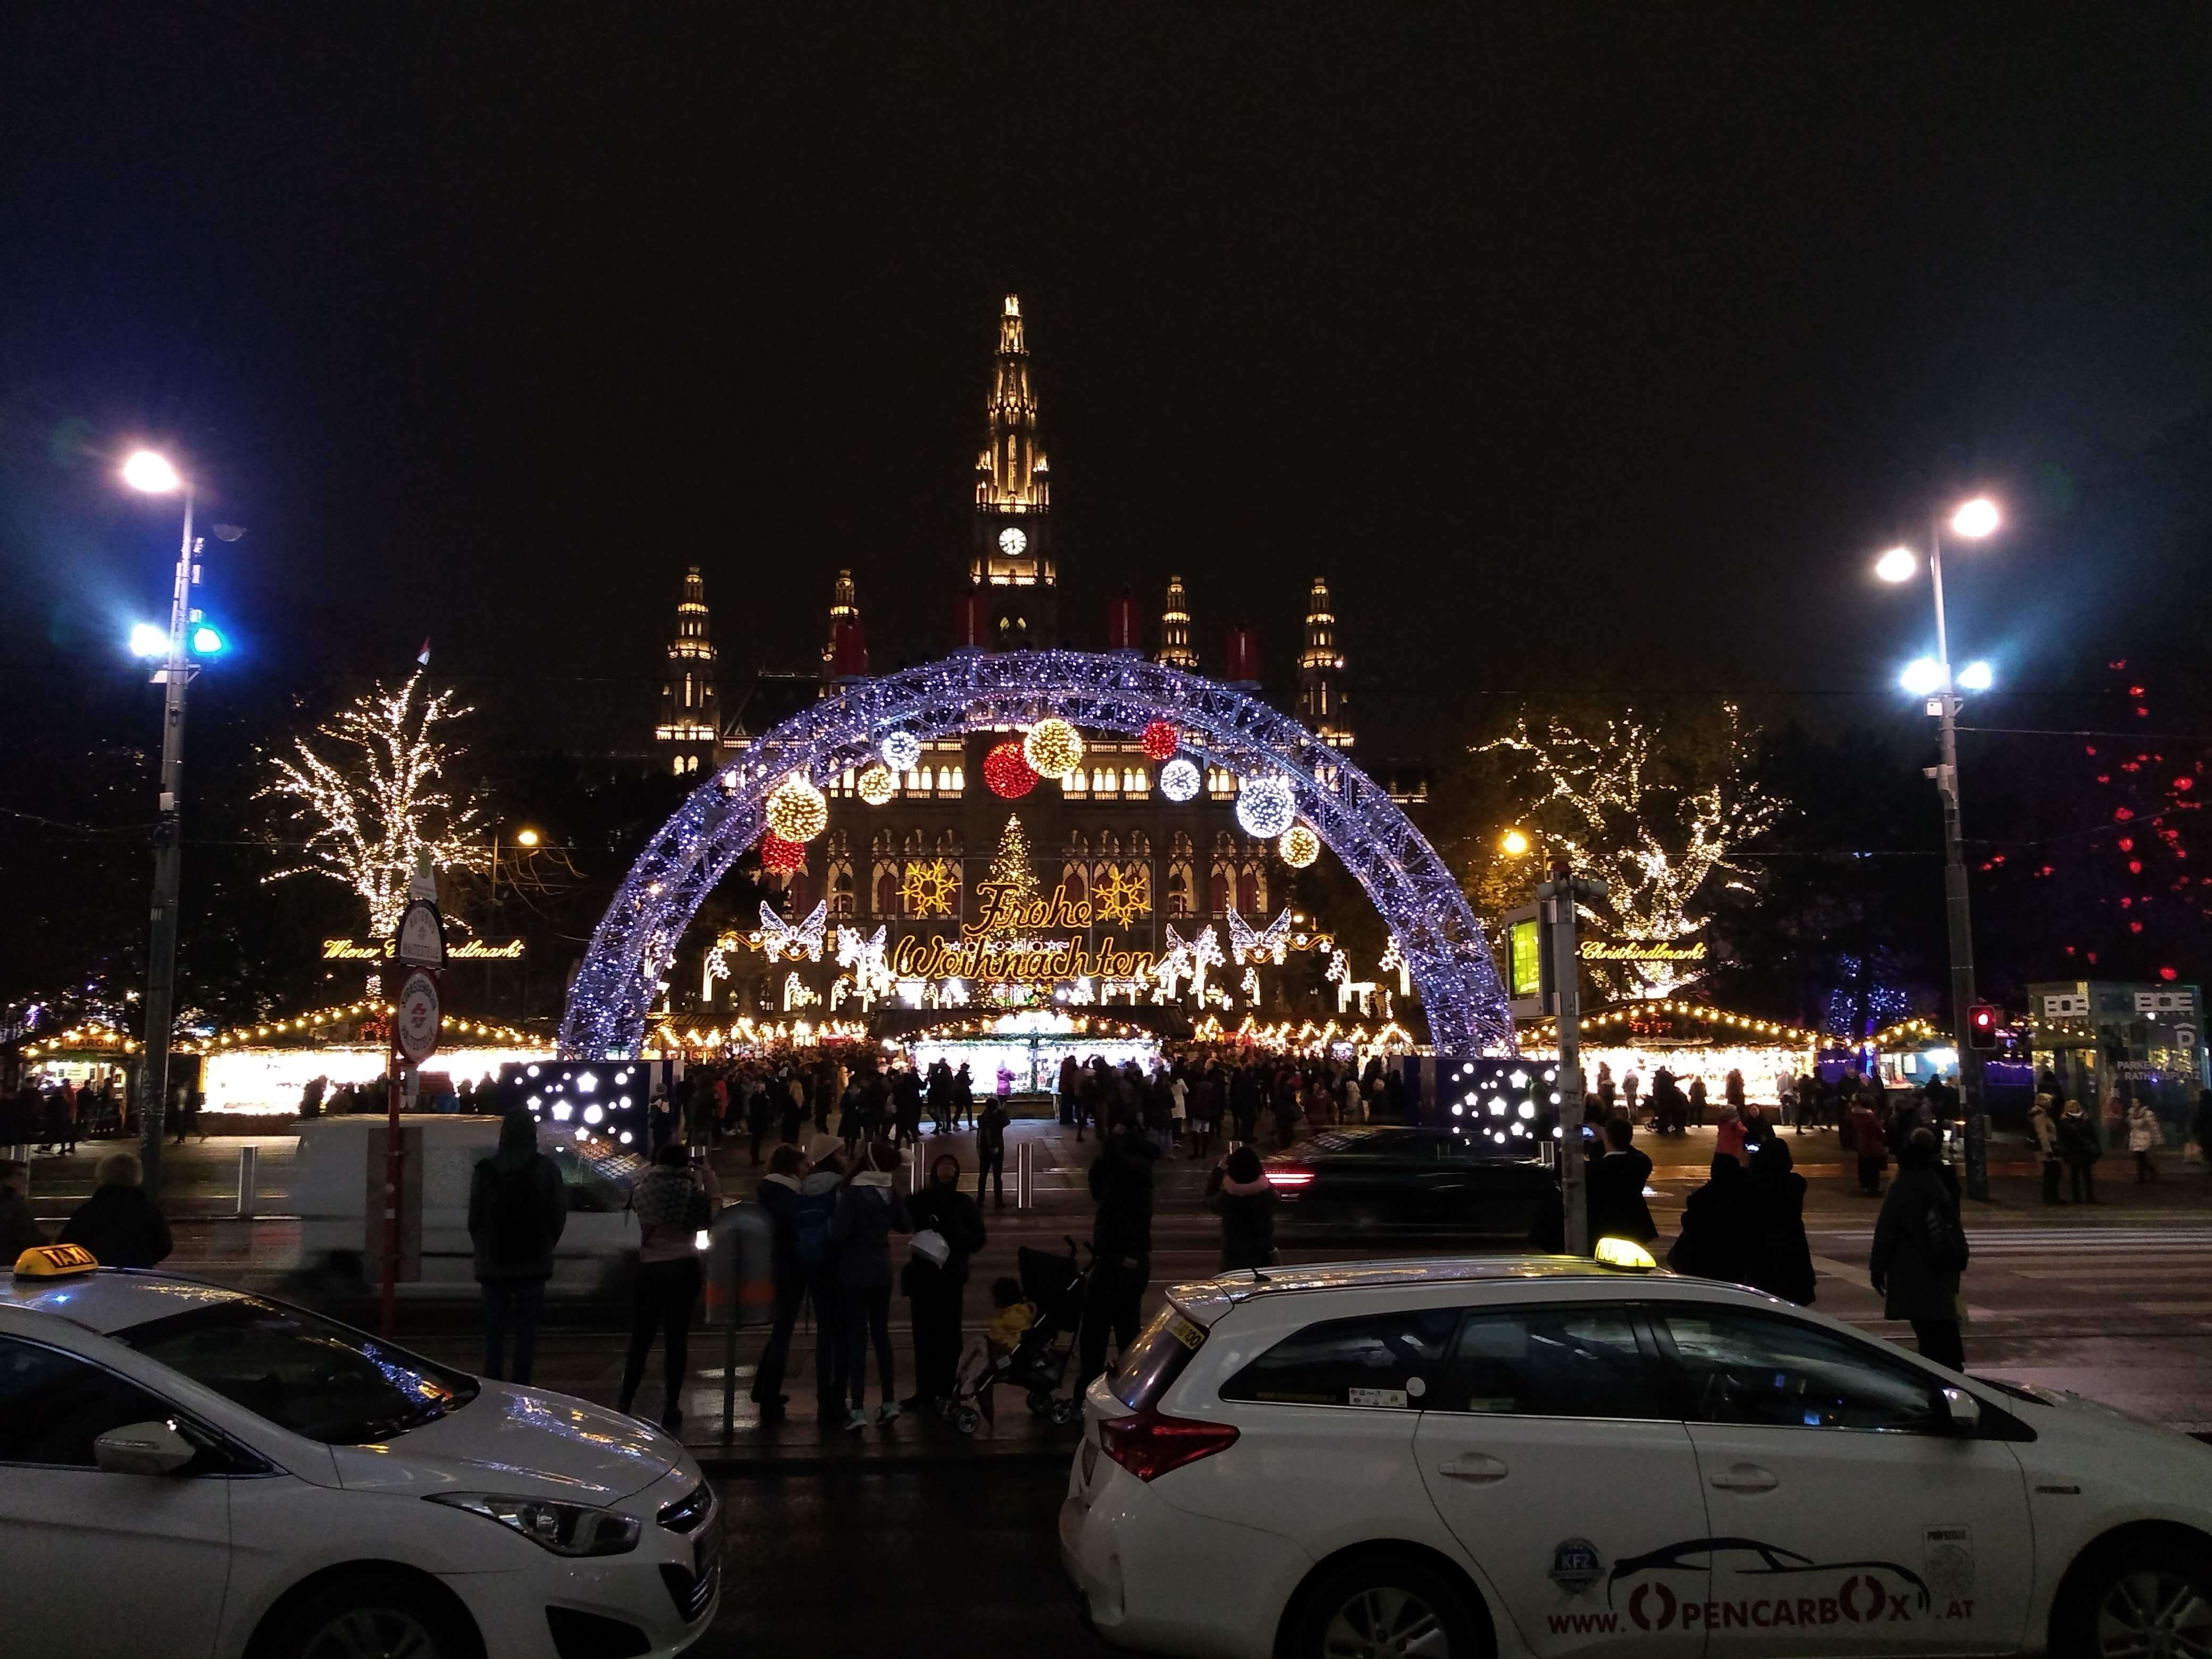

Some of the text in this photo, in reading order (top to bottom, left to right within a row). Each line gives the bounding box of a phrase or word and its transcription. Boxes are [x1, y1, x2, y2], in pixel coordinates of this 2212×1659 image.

[962, 882, 1093, 936] Frohe
[323, 939, 525, 958] Wiener Cindlmarkt
[894, 934, 1157, 980] Weihnachten
[1580, 941, 1708, 960] Christkindlmarkt
[65, 1038, 121, 1047] MARONI
[43, 1246, 91, 1267] TAXI
[1561, 1553, 1591, 1570] KFZ
